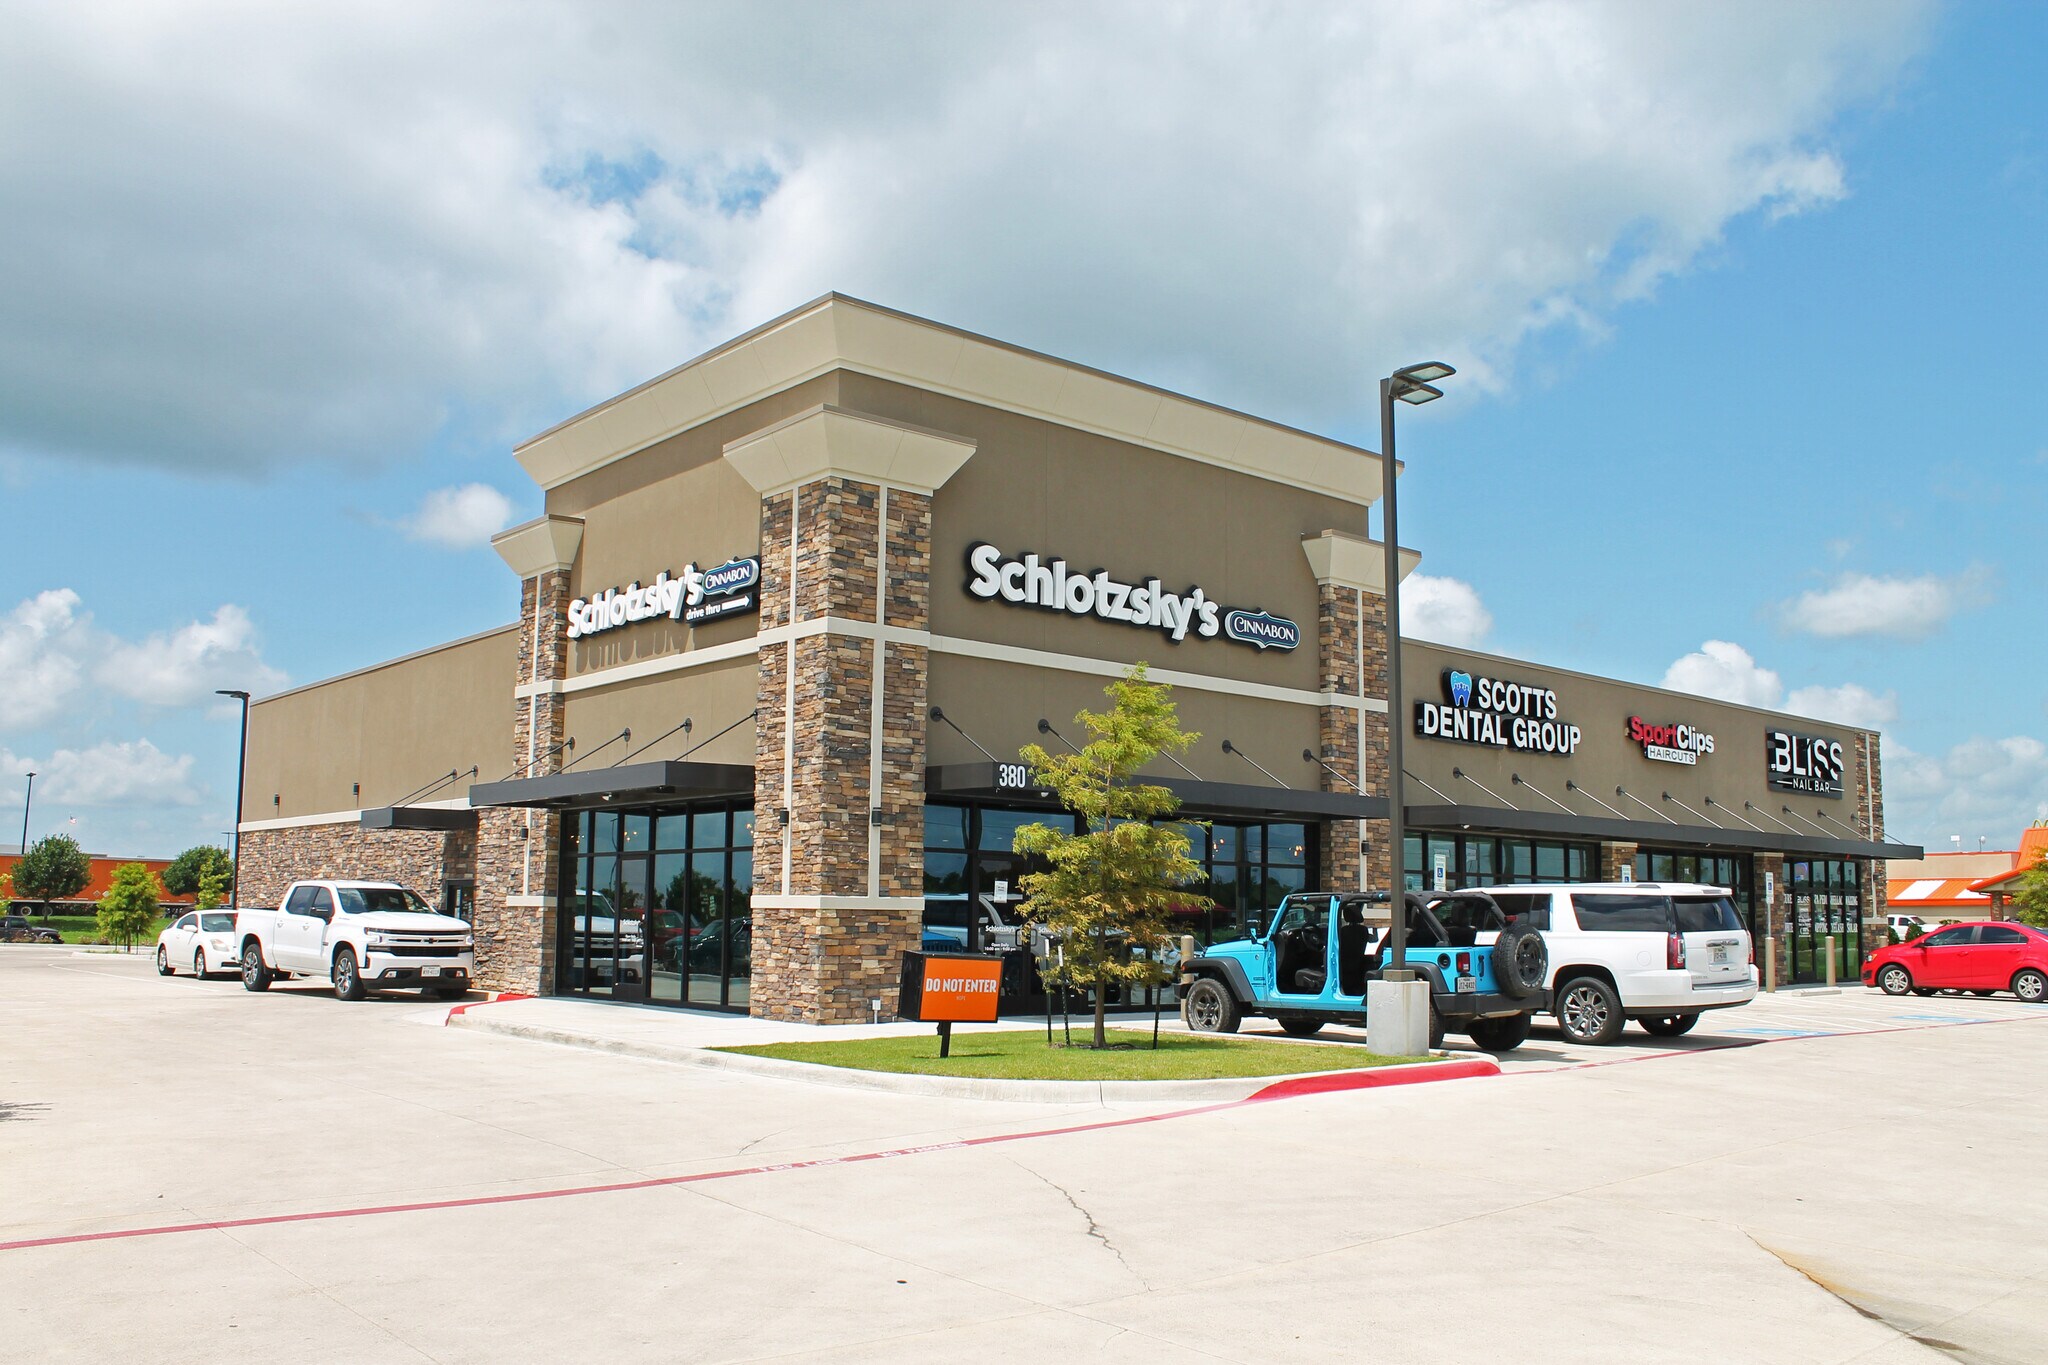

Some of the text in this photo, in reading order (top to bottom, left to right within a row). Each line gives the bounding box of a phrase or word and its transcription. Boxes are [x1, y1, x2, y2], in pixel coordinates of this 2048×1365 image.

[705, 565, 750, 589] CINNABON
[566, 563, 704, 638] Schlotzsky's
[970, 544, 1219, 641] Schlotzsky's
[686, 604, 721, 621] drive thru
[1234, 616, 1296, 642] CINNABON
[1478, 677, 1557, 720] SCOTTS
[1423, 702, 1581, 754] DENTAL GROUP
[1649, 747, 1695, 763] HAIRCUTS
[1774, 732, 1845, 781] BLISS
[999, 763, 1026, 788] 380
[1793, 777, 1830, 793] NAIL BAR
[925, 978, 997, 993] DO NOT ENTER
